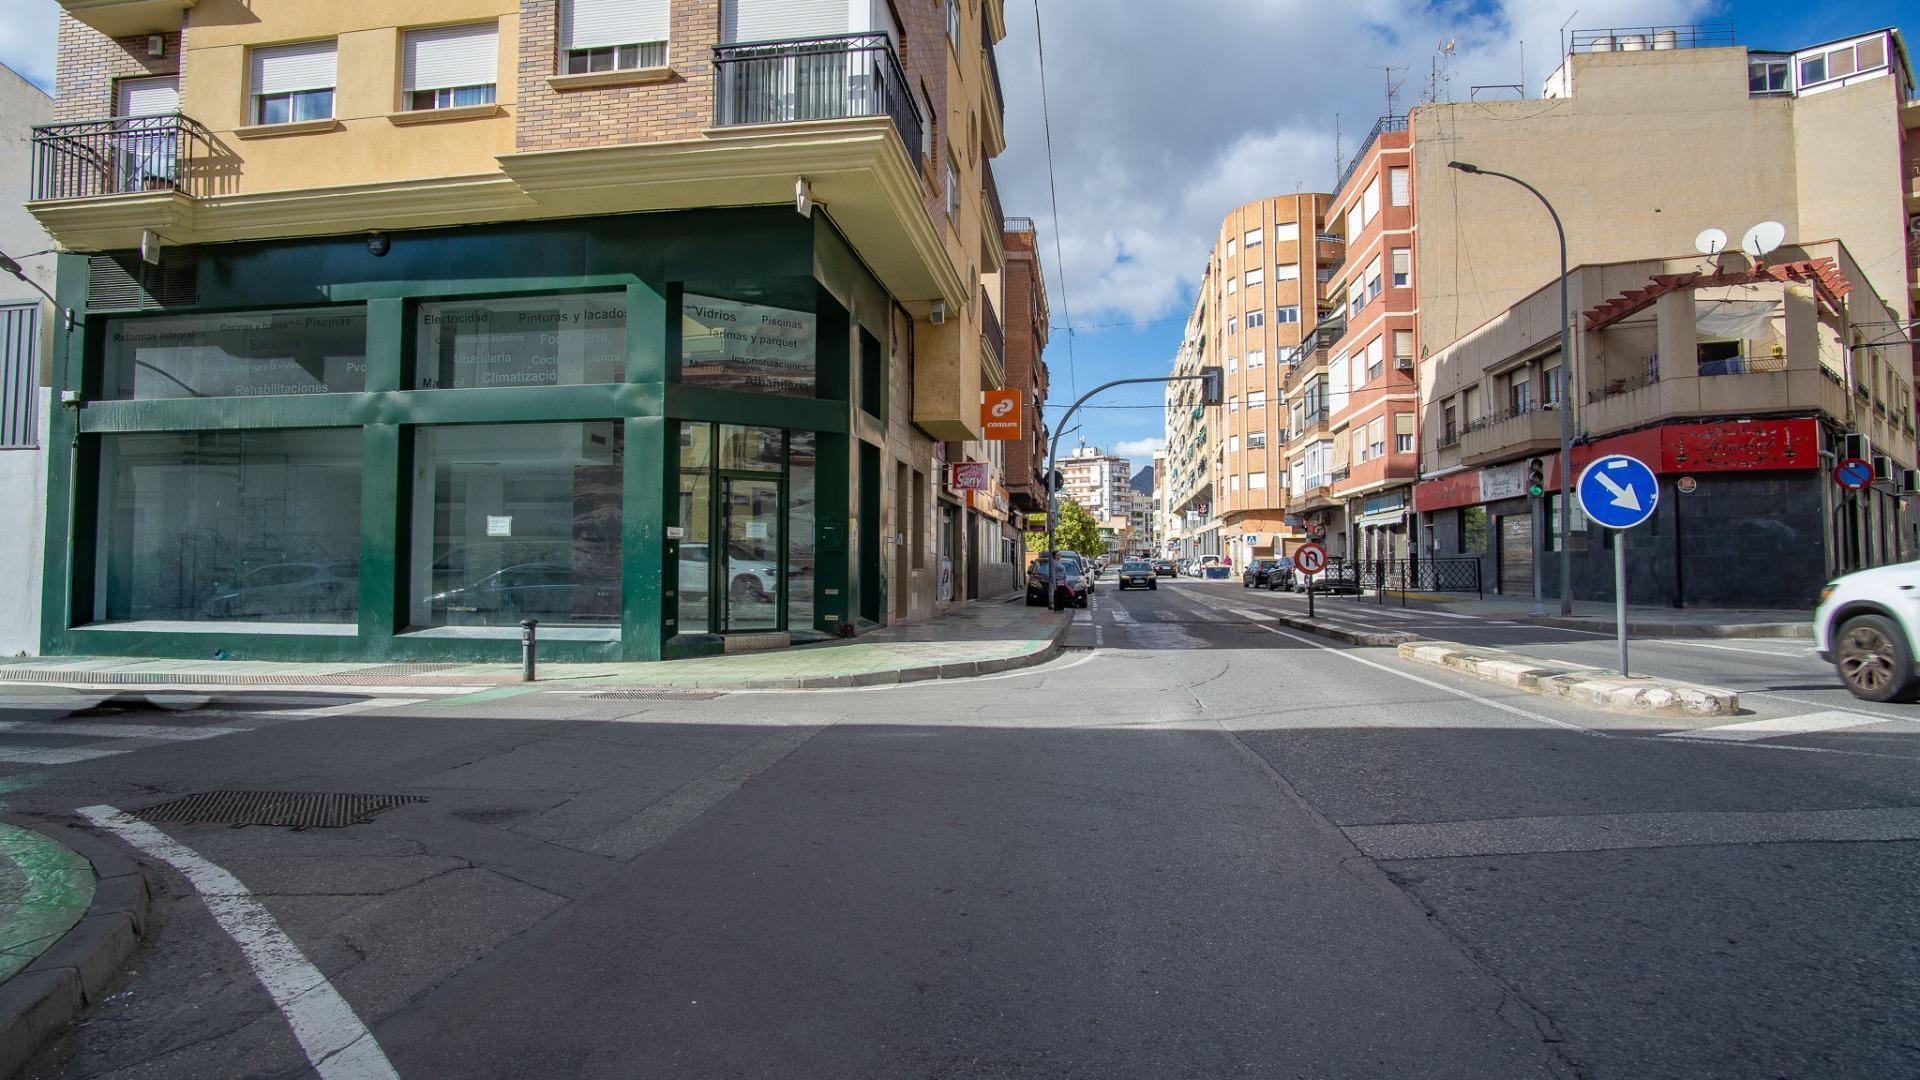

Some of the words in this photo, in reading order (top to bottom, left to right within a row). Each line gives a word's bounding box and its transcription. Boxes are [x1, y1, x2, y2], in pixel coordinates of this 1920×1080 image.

[305, 317, 351, 329] Piscinas
[424, 312, 488, 325] Electricidad
[519, 311, 568, 323] Pinturas
[572, 313, 580, 325] y
[696, 307, 737, 322] Vidrios
[761, 315, 803, 330] Piscinas
[113, 331, 157, 343] Reformas
[708, 328, 747, 342] Tarimas
[750, 334, 758, 344] y
[760, 337, 798, 349] parquet
[482, 370, 560, 384] Climatizació
[235, 383, 329, 397] Rehabilitaciones
